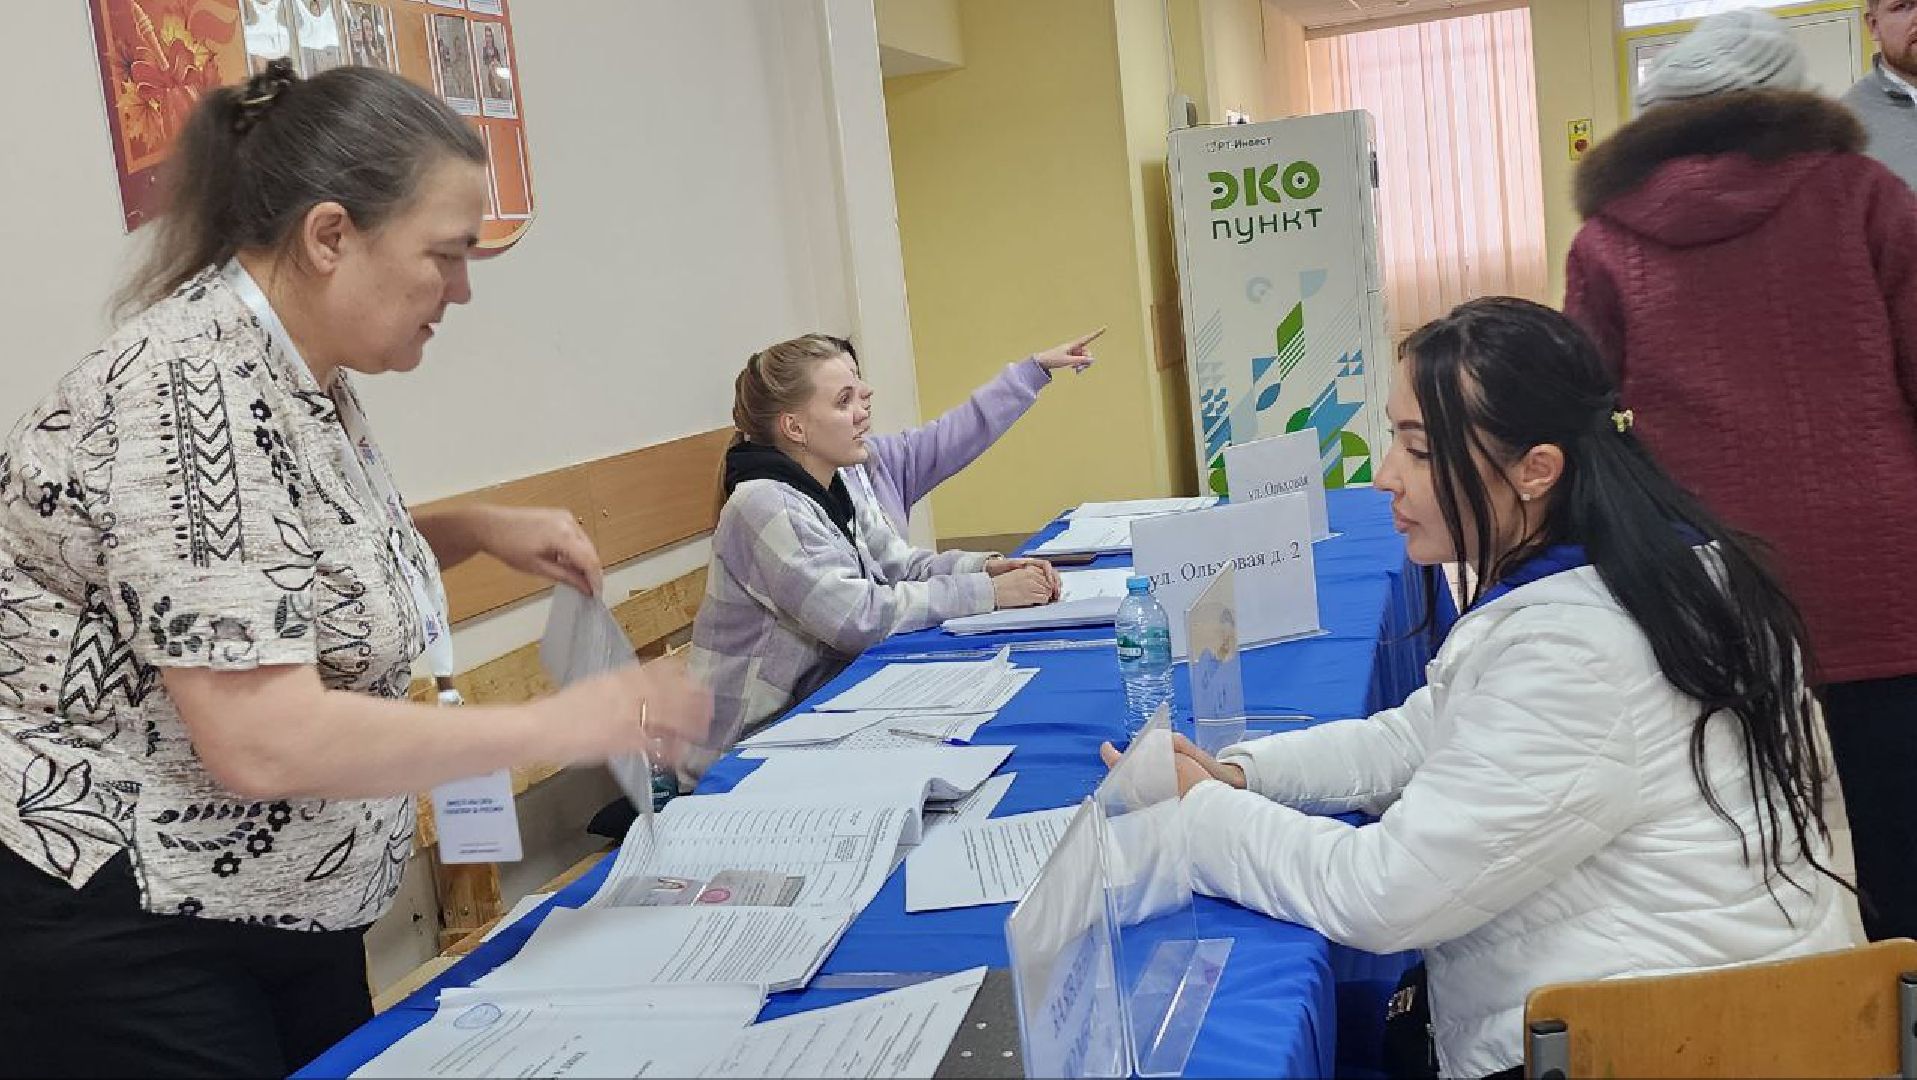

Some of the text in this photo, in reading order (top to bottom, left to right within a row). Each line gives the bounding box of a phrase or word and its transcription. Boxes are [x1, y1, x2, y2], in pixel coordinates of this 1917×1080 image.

[1208, 160, 1321, 211] ЭКО
[1149, 572, 1176, 593] ул.
[1270, 549, 1285, 566] д.
[1290, 541, 1301, 559] 2
